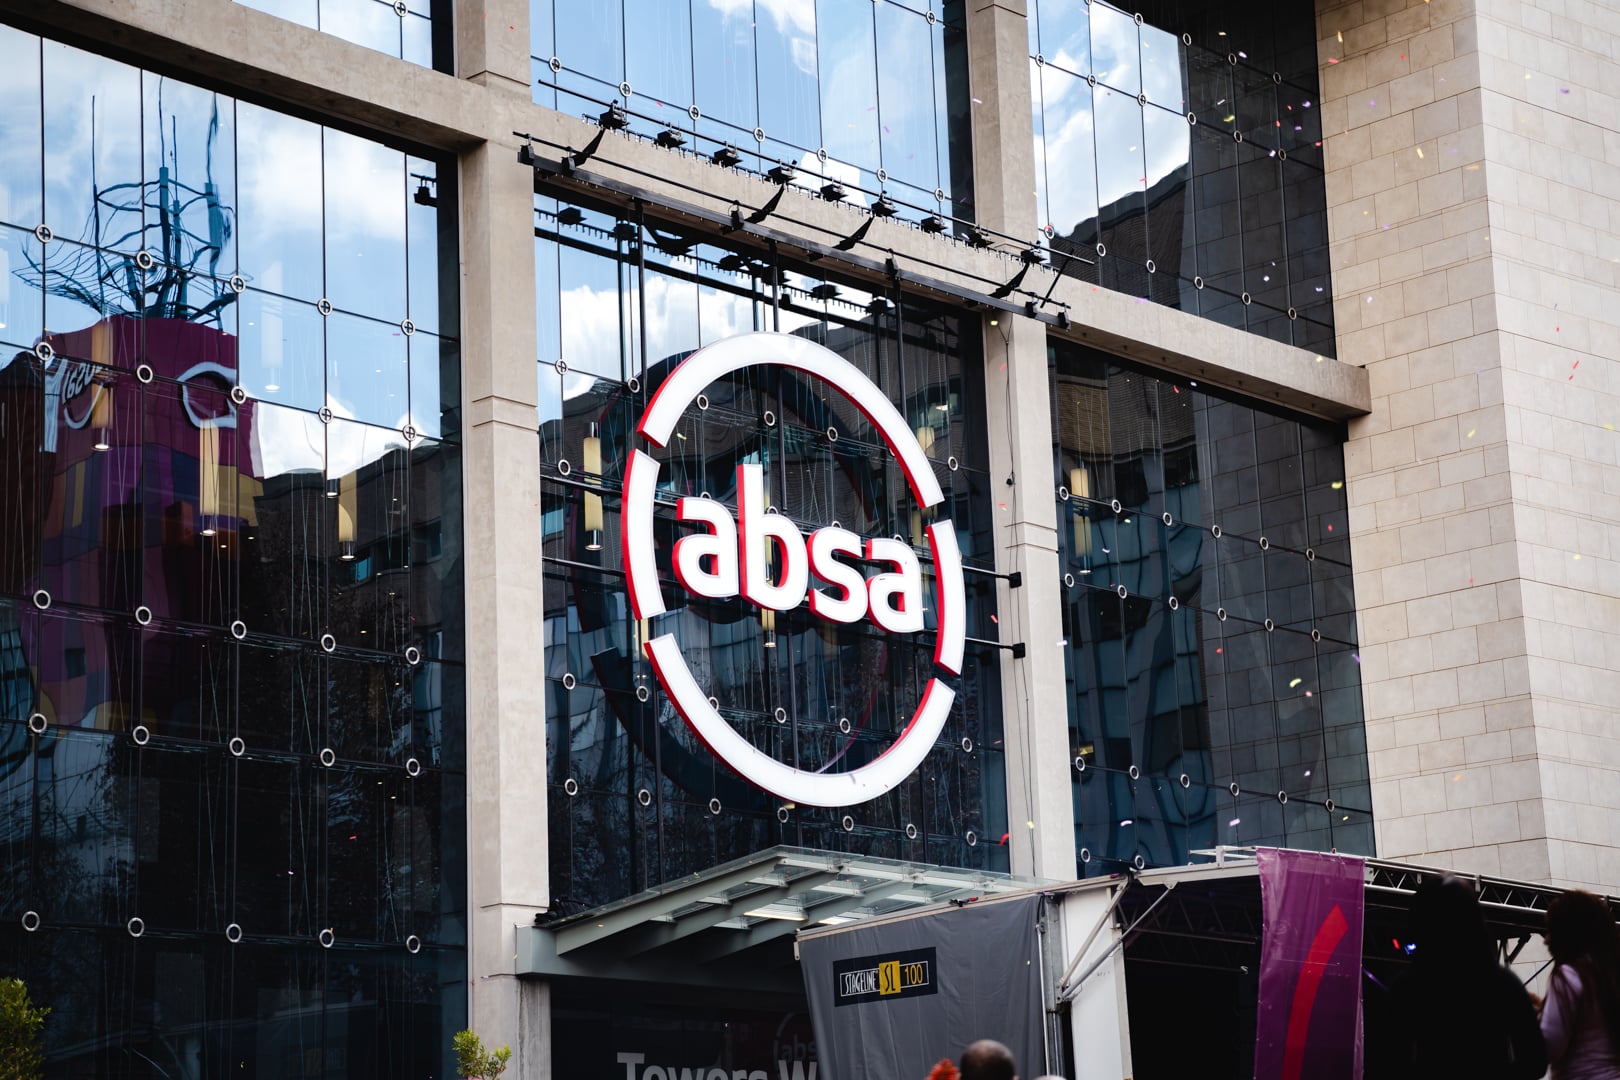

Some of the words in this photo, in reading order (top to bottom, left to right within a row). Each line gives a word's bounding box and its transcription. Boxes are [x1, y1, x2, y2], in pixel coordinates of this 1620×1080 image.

[672, 463, 924, 633] absa
[844, 970, 877, 995] STAGELINE
[884, 963, 896, 992] SL
[904, 964, 923, 985] 100
